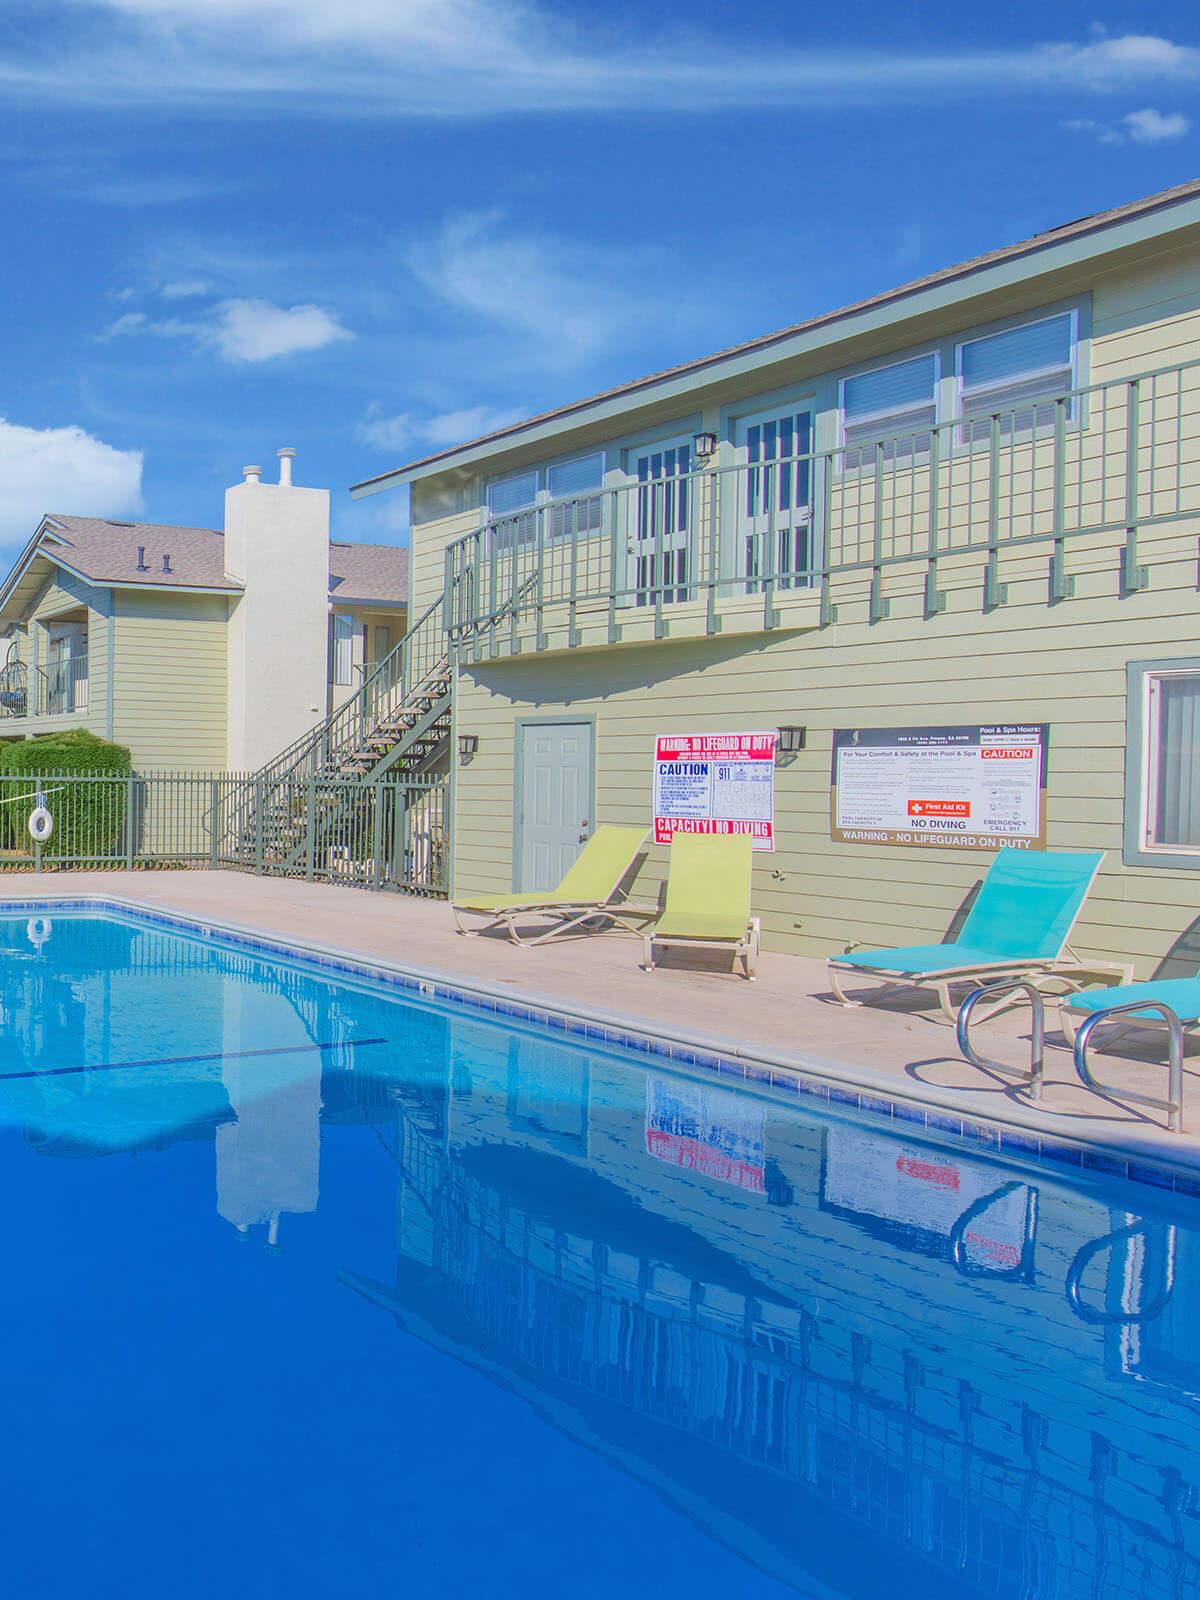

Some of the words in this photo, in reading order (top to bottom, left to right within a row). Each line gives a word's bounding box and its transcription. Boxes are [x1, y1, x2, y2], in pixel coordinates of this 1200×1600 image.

[1003, 727, 1016, 735] Spa
[703, 737, 739, 751] LIFEGUARD
[741, 736, 751, 750] ON
[753, 736, 774, 750] DUTY
[983, 750, 1030, 758] CAUTION
[659, 764, 708, 775] CAUTION
[719, 768, 730, 780] 911
[658, 819, 708, 833] CAPACITY
[716, 820, 729, 834] NO
[733, 821, 768, 836] DIVING
[912, 819, 926, 828] NO
[930, 820, 966, 829] DIVING
[842, 831, 888, 841] WARNING
[897, 832, 911, 842] NO
[914, 833, 976, 846] LIFEGUARD
[979, 838, 996, 847] ON
[1000, 839, 1031, 848] DUTY
